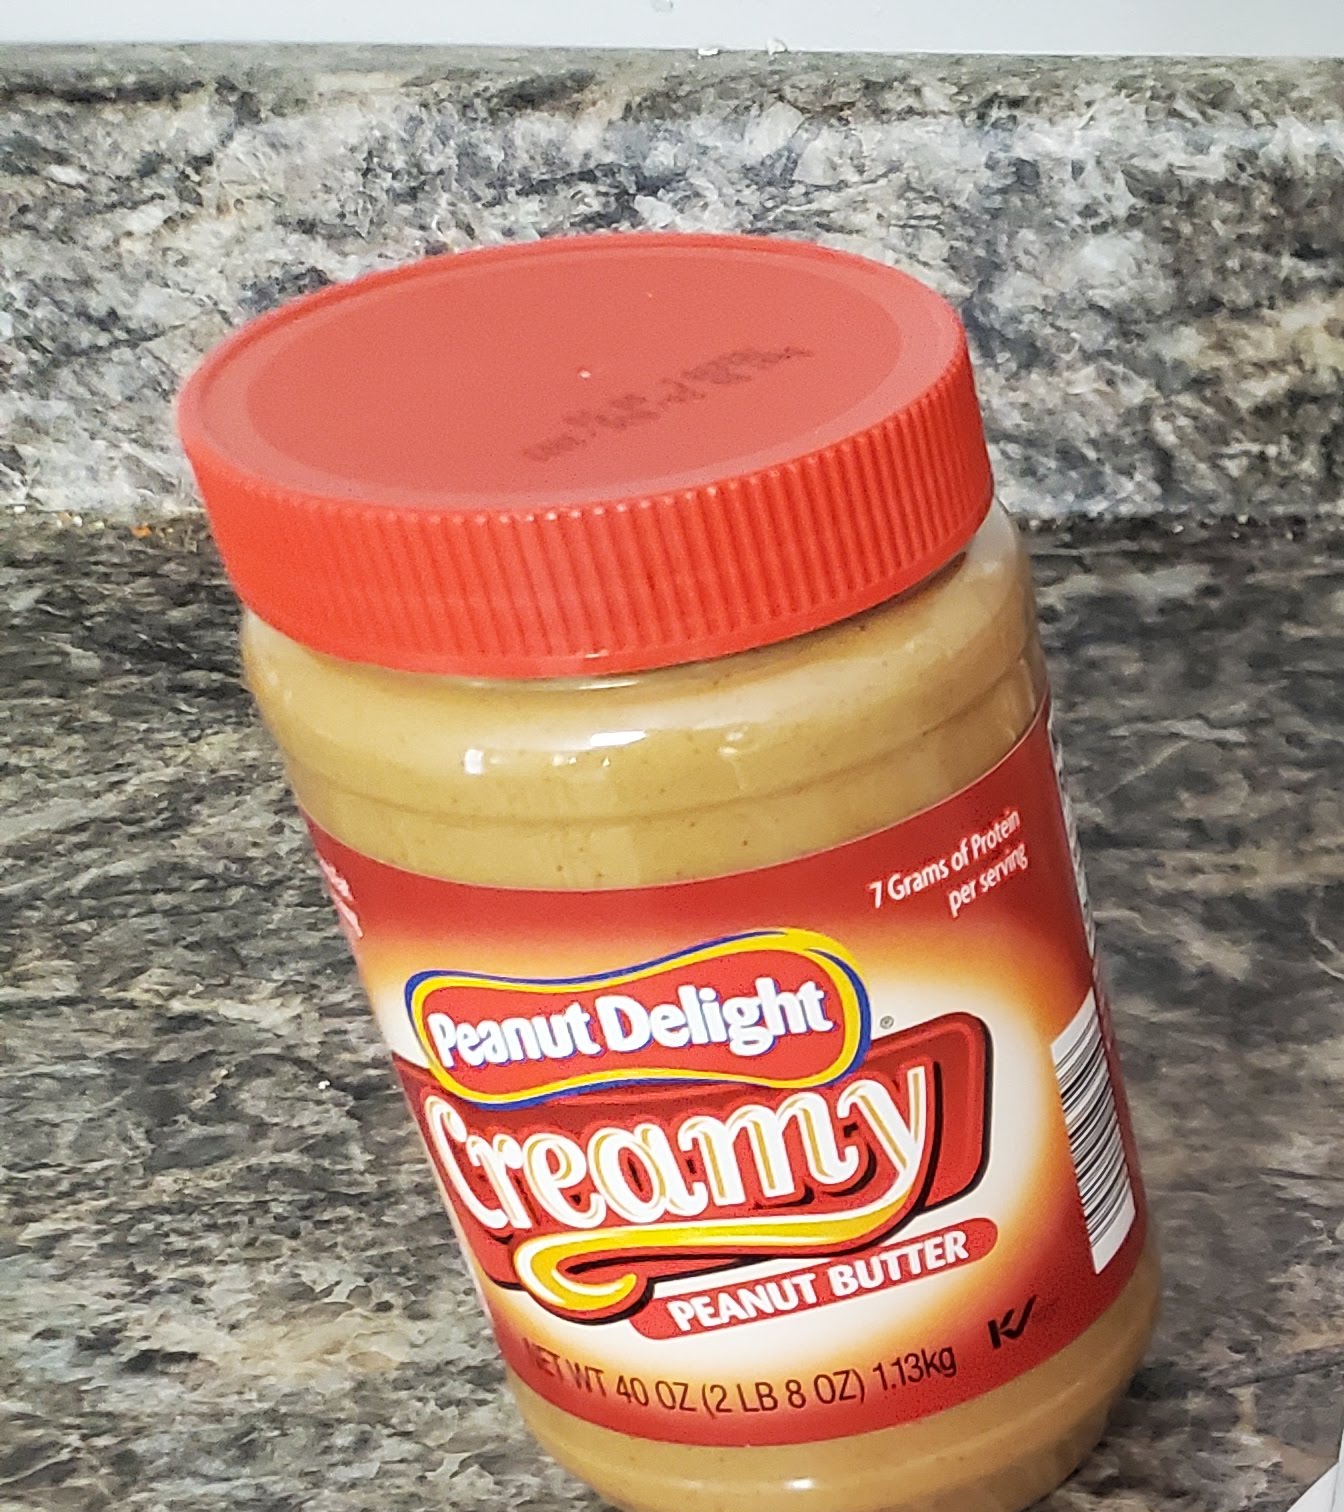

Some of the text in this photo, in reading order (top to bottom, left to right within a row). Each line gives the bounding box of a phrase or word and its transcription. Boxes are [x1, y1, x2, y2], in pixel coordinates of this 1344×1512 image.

[869, 807, 1021, 909] 7 Grams of Protein
[949, 842, 1029, 918] per serving
[426, 976, 835, 1069] Peanut Delight
[424, 1066, 927, 1260] Creamy
[667, 1230, 970, 1332] PEANUT BUTTER
[565, 1357, 607, 1398] WT
[615, 1375, 650, 1407] 40
[654, 1380, 698, 1412] OZ
[701, 1383, 733, 1419] (2
[736, 1381, 778, 1412] LB
[784, 1379, 806, 1409] 8
[813, 1368, 866, 1405] OZ)
[872, 1346, 957, 1392] 1.13kg
